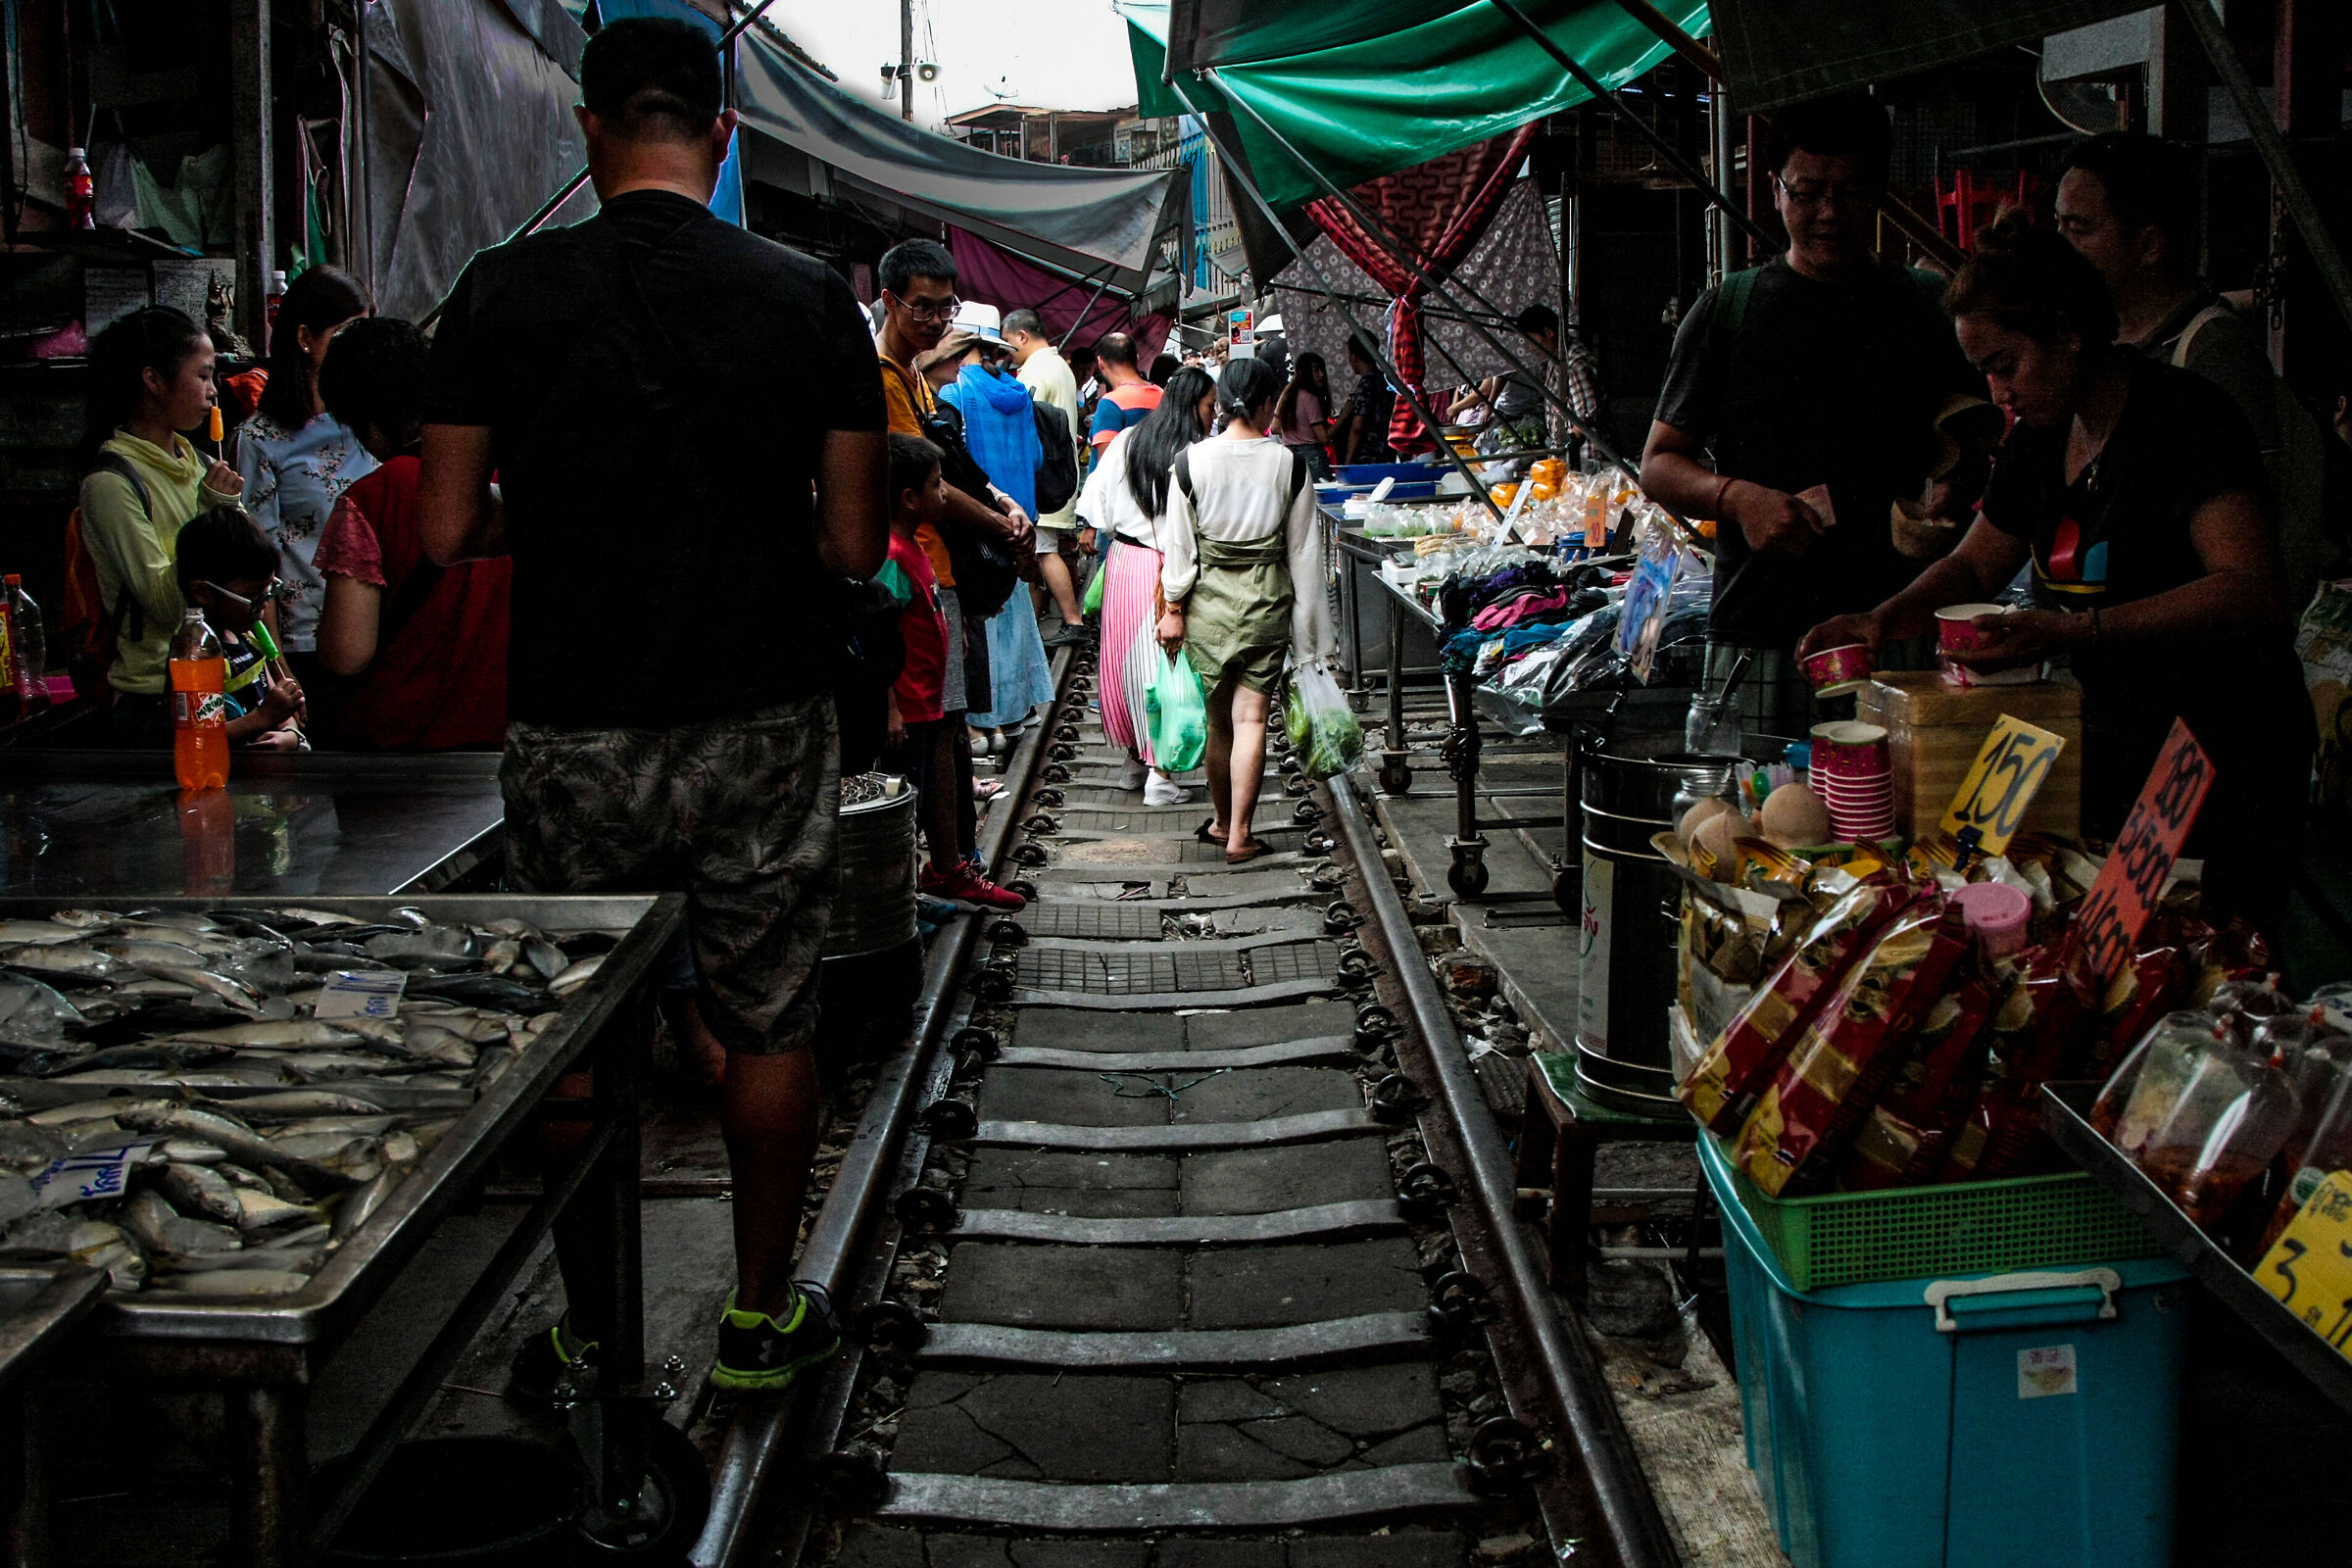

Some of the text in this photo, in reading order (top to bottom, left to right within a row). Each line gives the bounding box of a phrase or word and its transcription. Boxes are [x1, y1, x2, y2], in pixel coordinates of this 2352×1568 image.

[197, 695, 224, 719] MIRIND
[1953, 731, 2057, 837] 150
[2156, 740, 2204, 830] 180
[2119, 802, 2170, 910] 3/500
